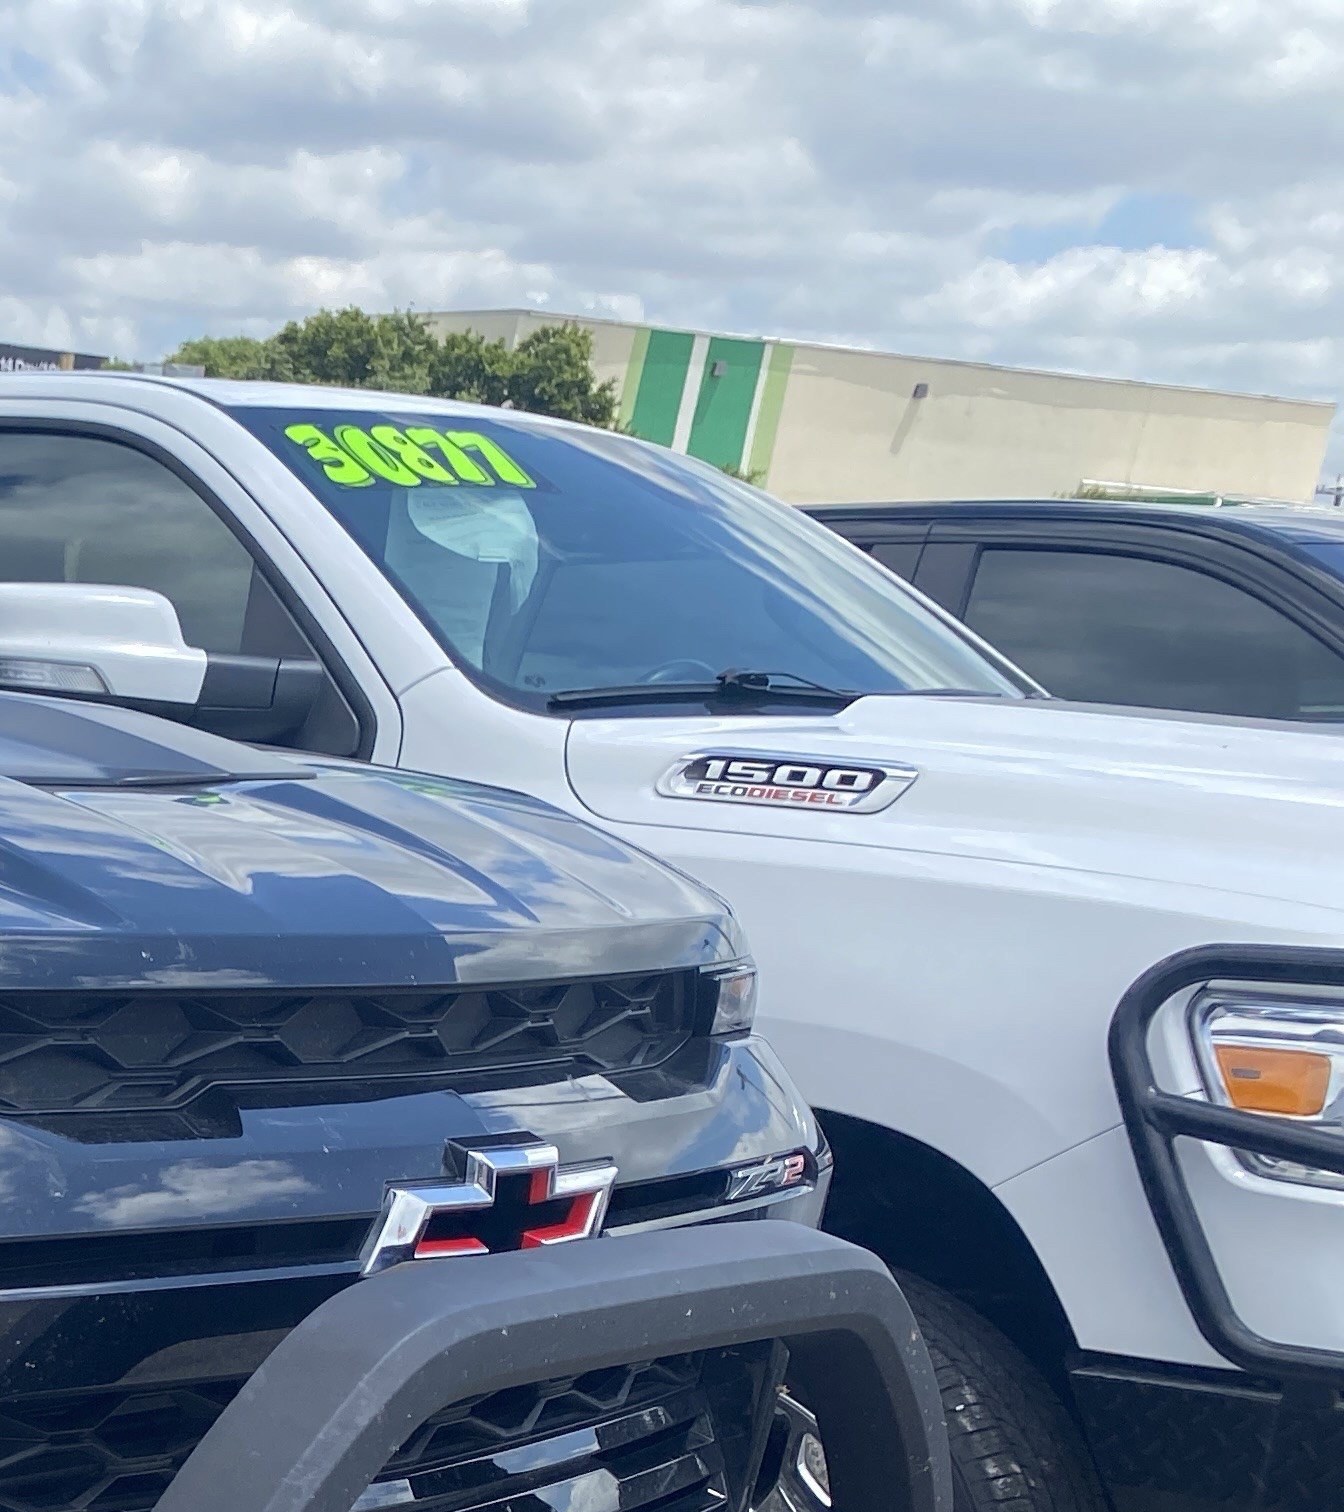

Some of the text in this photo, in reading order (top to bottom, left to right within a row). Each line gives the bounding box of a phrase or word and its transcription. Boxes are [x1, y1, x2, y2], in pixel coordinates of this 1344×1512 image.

[284, 424, 537, 489] 30877
[696, 783, 843, 805] ECODIESEL
[706, 759, 873, 792] 1500
[725, 1154, 804, 1200] ZR2
